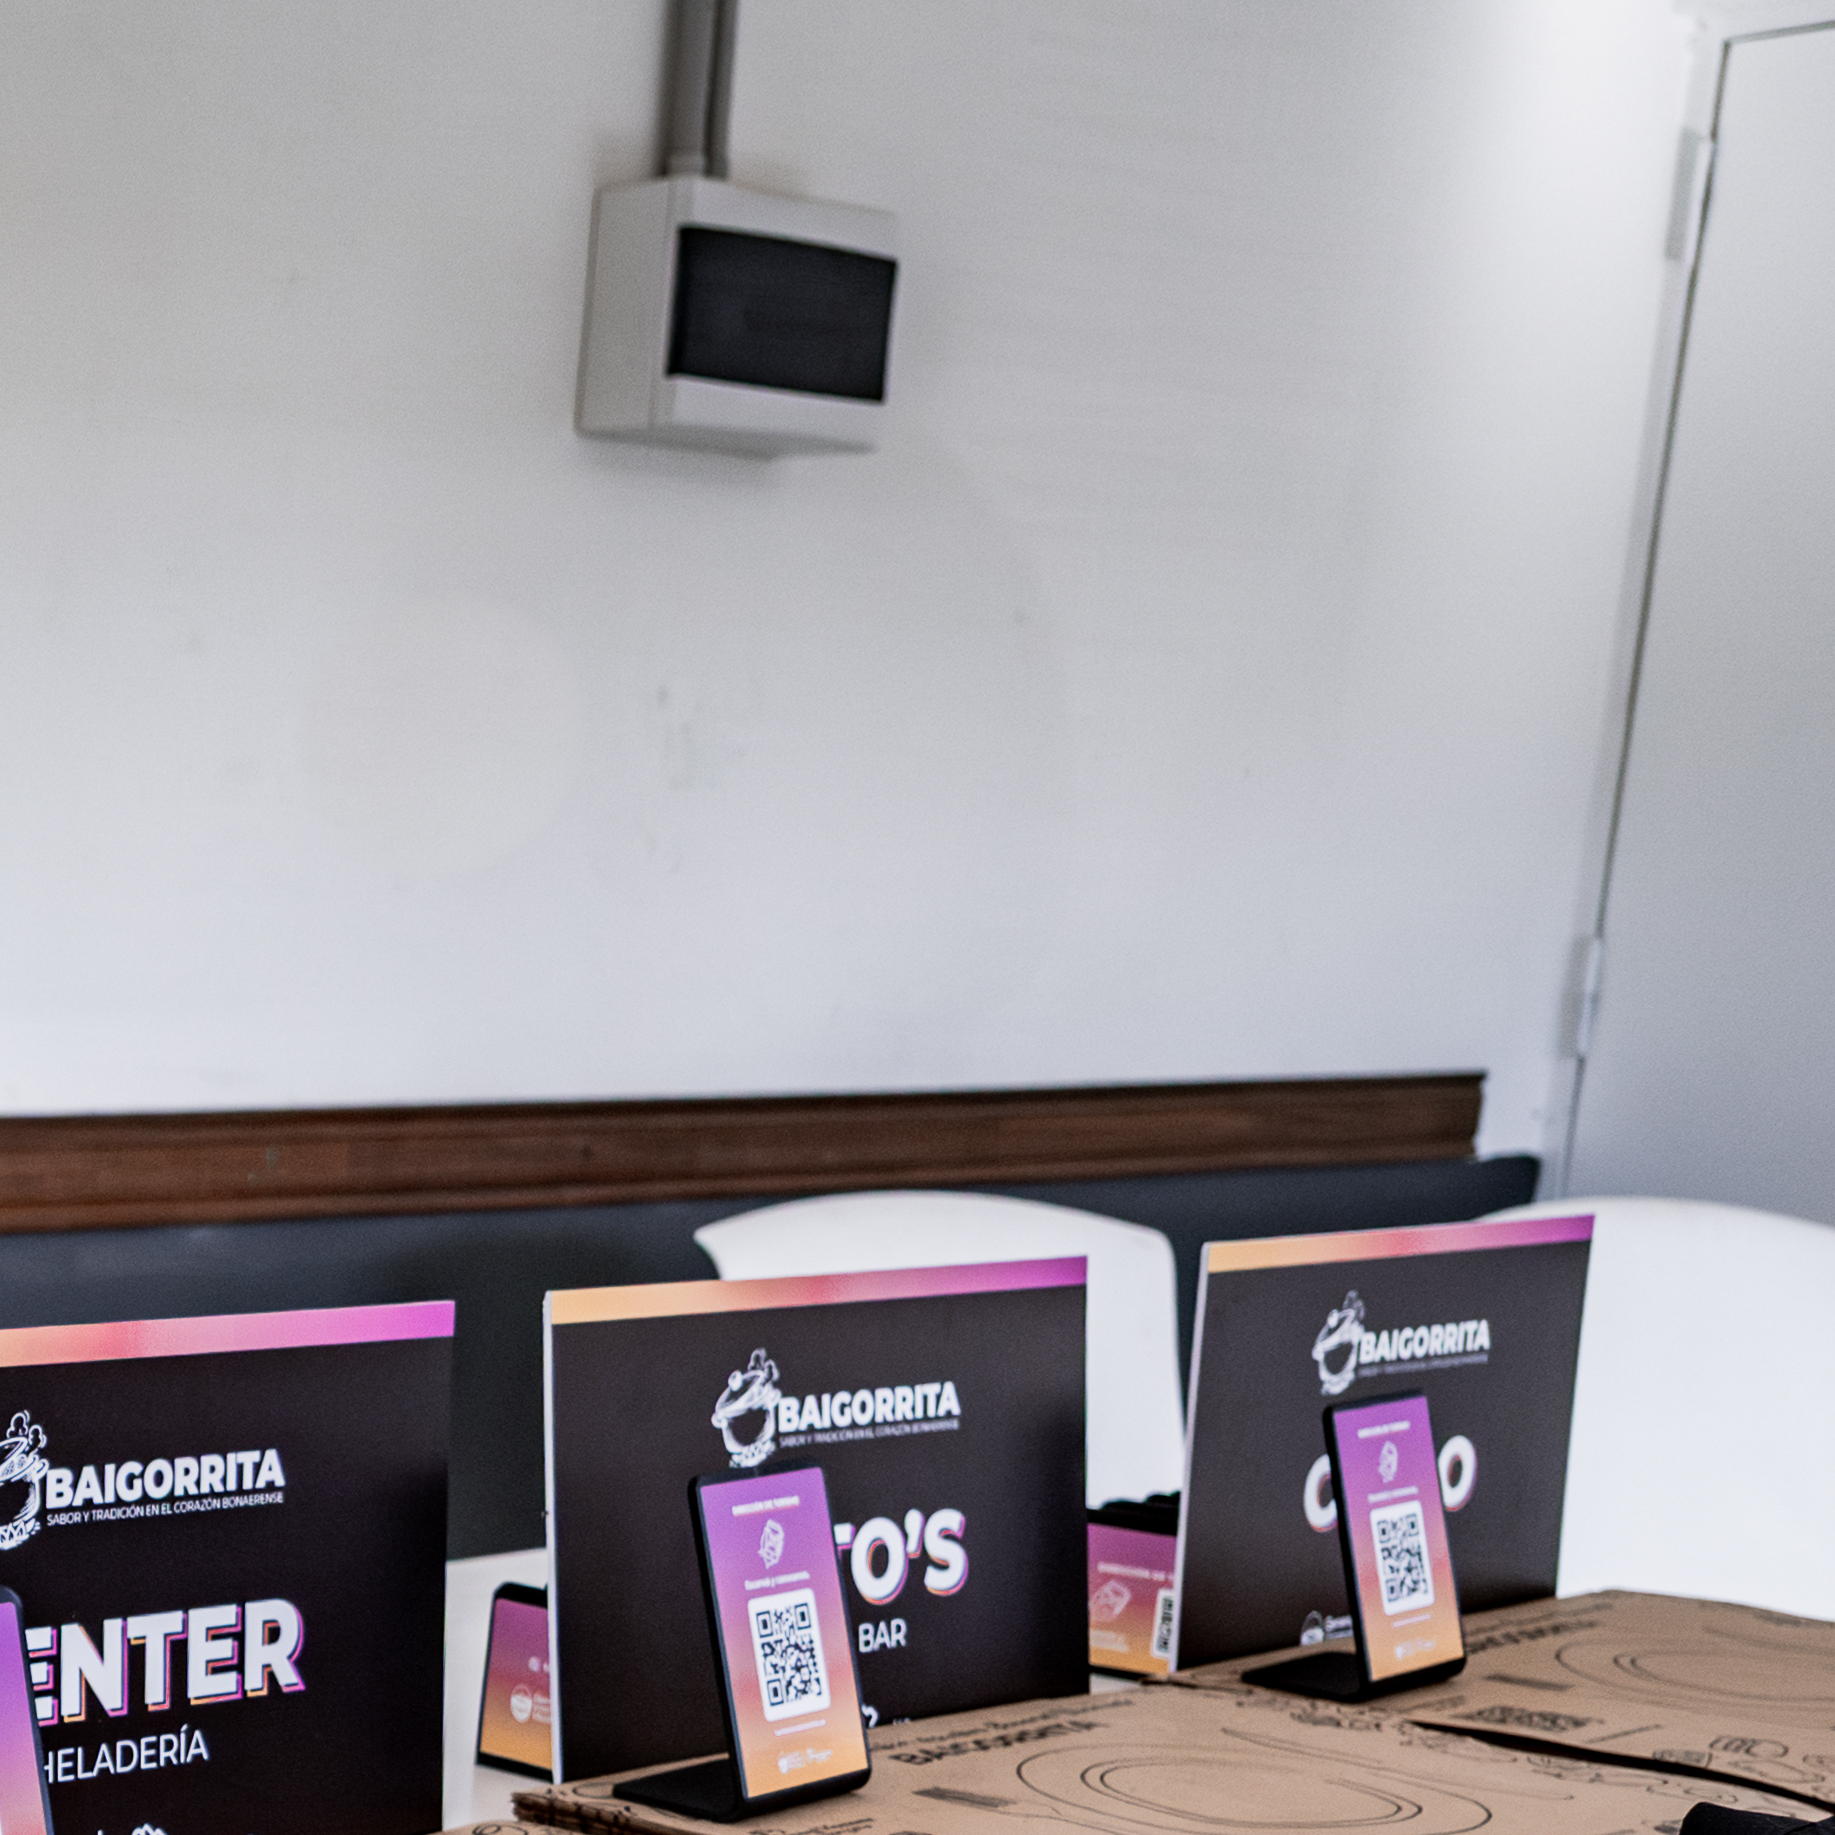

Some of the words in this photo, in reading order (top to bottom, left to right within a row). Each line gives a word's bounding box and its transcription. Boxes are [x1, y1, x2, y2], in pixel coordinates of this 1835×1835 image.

[1359, 1318, 1490, 1364] BAIGORRITA
[778, 1380, 962, 1433] BAIGORRITA
[45, 1448, 286, 1509] BAIGORRITA
[46, 1512, 81, 1526] SABOR
[82, 1511, 89, 1523] Y
[92, 1504, 144, 1521] TRADICIÓN
[145, 1504, 159, 1516] EN
[161, 1503, 172, 1515] EL
[833, 1508, 969, 1605] O'S
[858, 1618, 907, 1653] BAR
